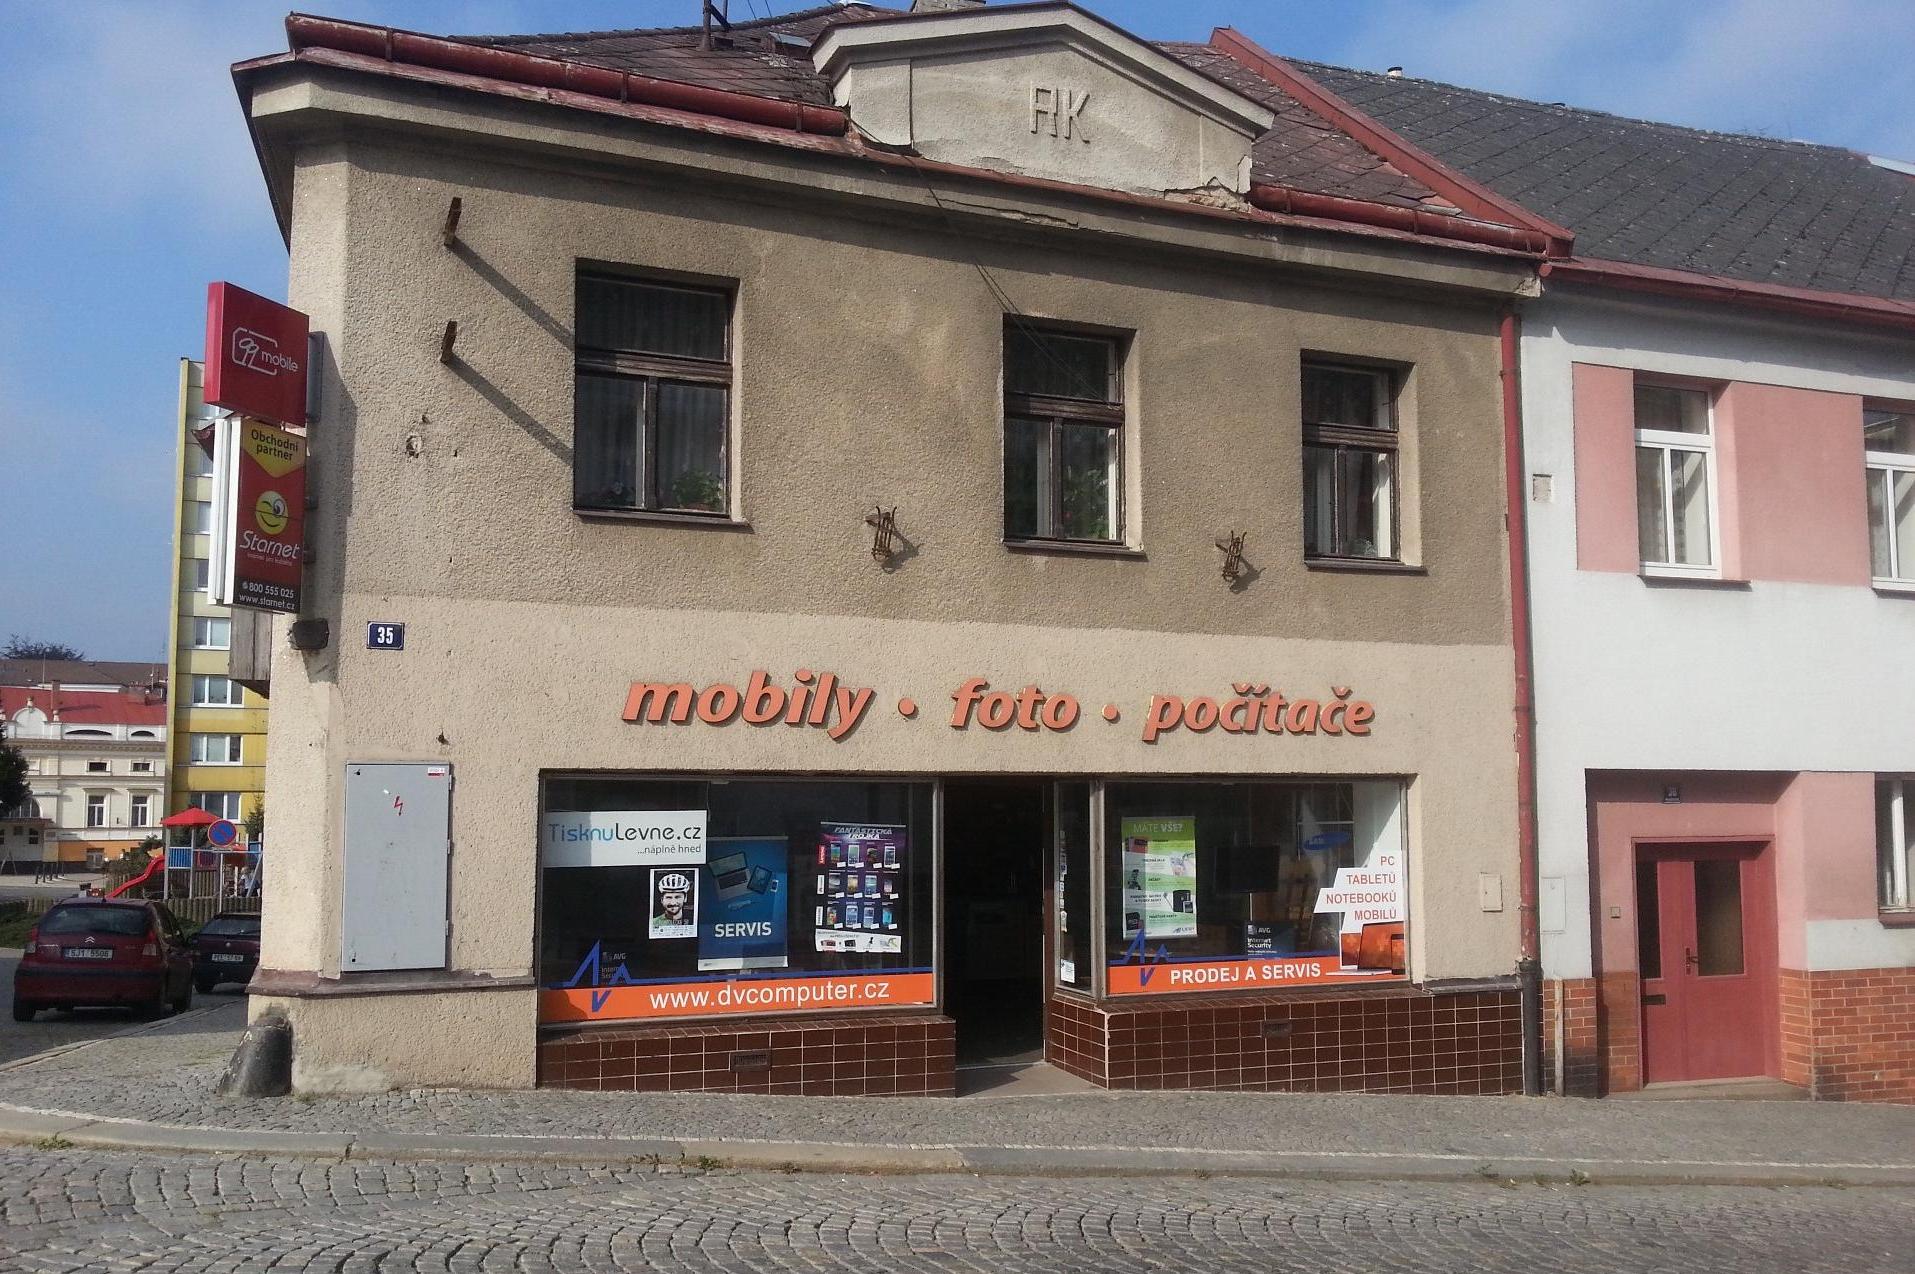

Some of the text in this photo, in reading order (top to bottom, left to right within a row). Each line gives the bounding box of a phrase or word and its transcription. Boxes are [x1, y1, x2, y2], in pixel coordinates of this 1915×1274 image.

[261, 350, 299, 373] mobile
[256, 443, 293, 462] partner
[240, 529, 300, 560] Starnet
[248, 582, 294, 599] 800 555 025
[239, 594, 295, 610] www.starnet.cz
[377, 626, 394, 645] 35
[622, 670, 1375, 743] mobily foto počítače
[549, 823, 701, 843] TisknuLevne.cz
[678, 843, 702, 854] hned
[1380, 855, 1395, 866] PC
[1346, 872, 1396, 884] TABLETŮ
[1326, 890, 1397, 904] NOTEBOOKŮ
[1354, 907, 1397, 920] MOBILŮ
[715, 921, 772, 937] SERVIS
[1247, 942, 1272, 950] Security
[1170, 963, 1321, 984] PRODEJ A SERVIS
[649, 981, 890, 1009] www.dvcomputer.cz
